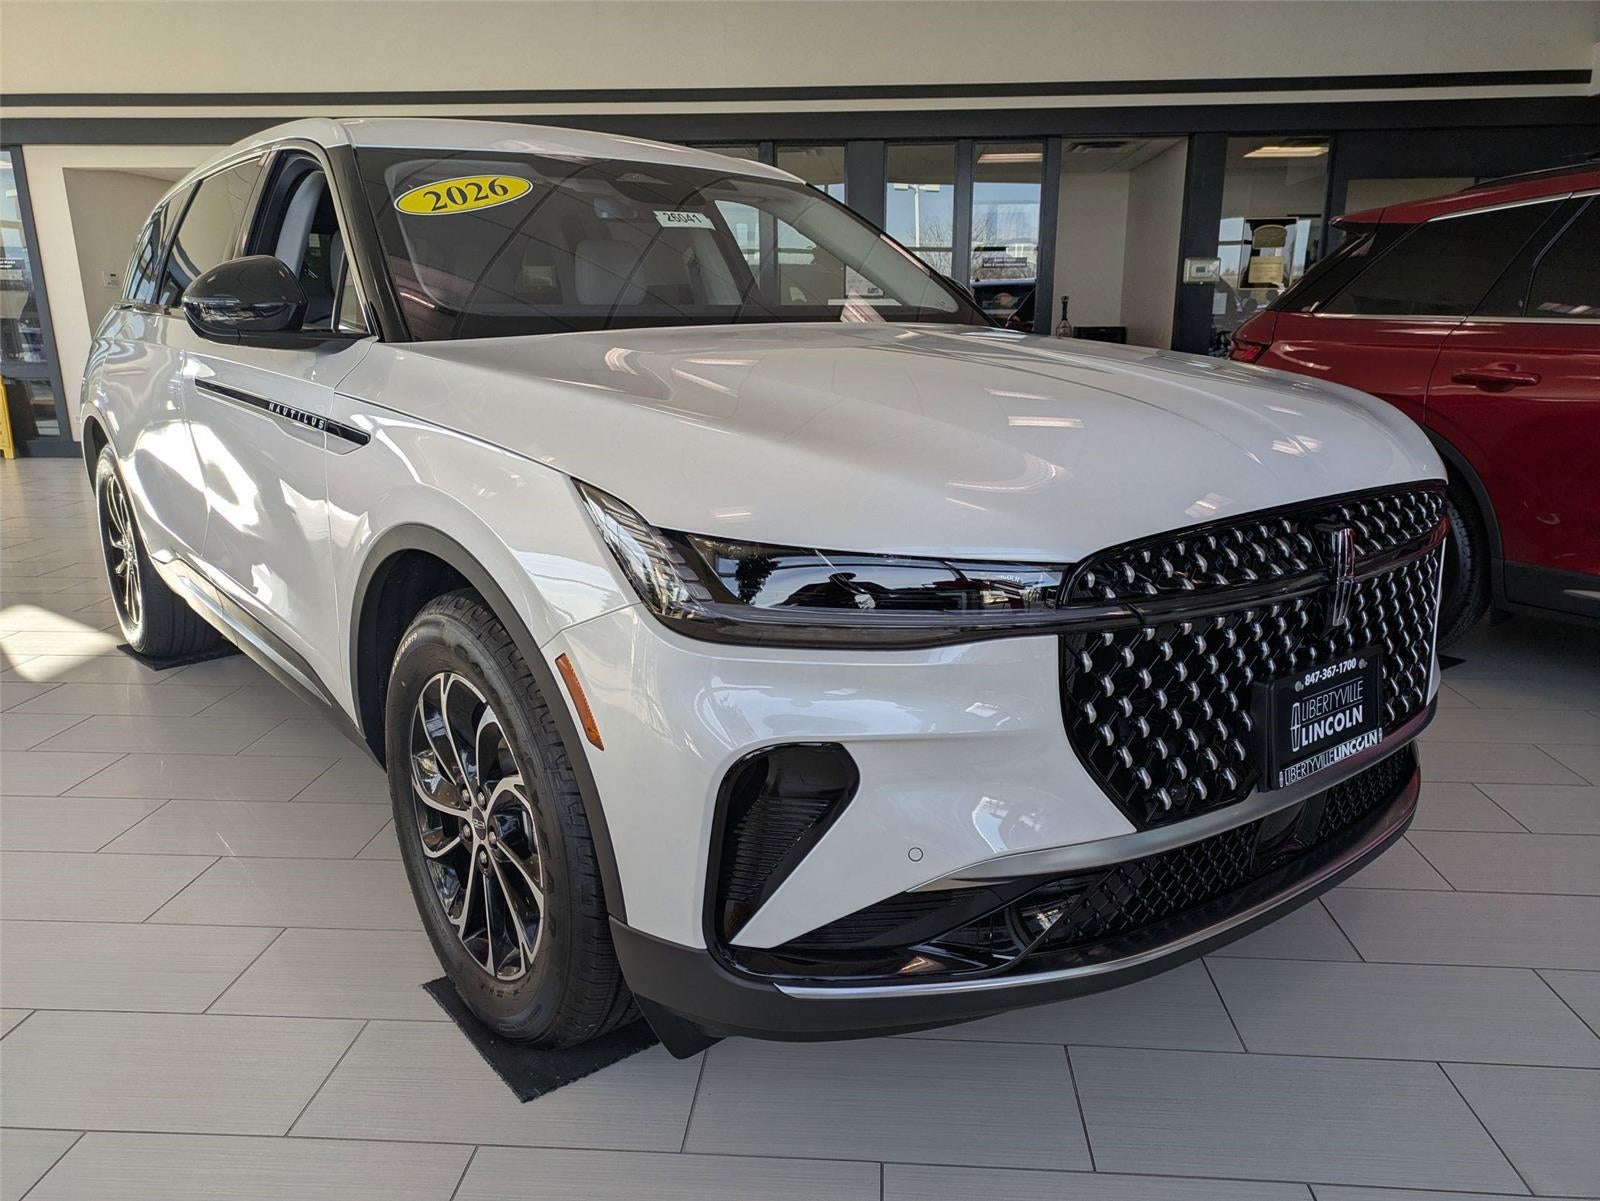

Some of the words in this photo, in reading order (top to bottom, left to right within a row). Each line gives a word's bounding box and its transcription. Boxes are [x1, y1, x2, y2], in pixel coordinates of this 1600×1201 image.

[423, 177, 509, 212] 2026
[662, 212, 702, 223] 26041
[269, 401, 325, 430] NAUTILUS
[1304, 658, 1357, 686] 847-367-1700
[1301, 680, 1364, 722] LIBERTYVILLE
[1301, 705, 1364, 747] LINCOLN
